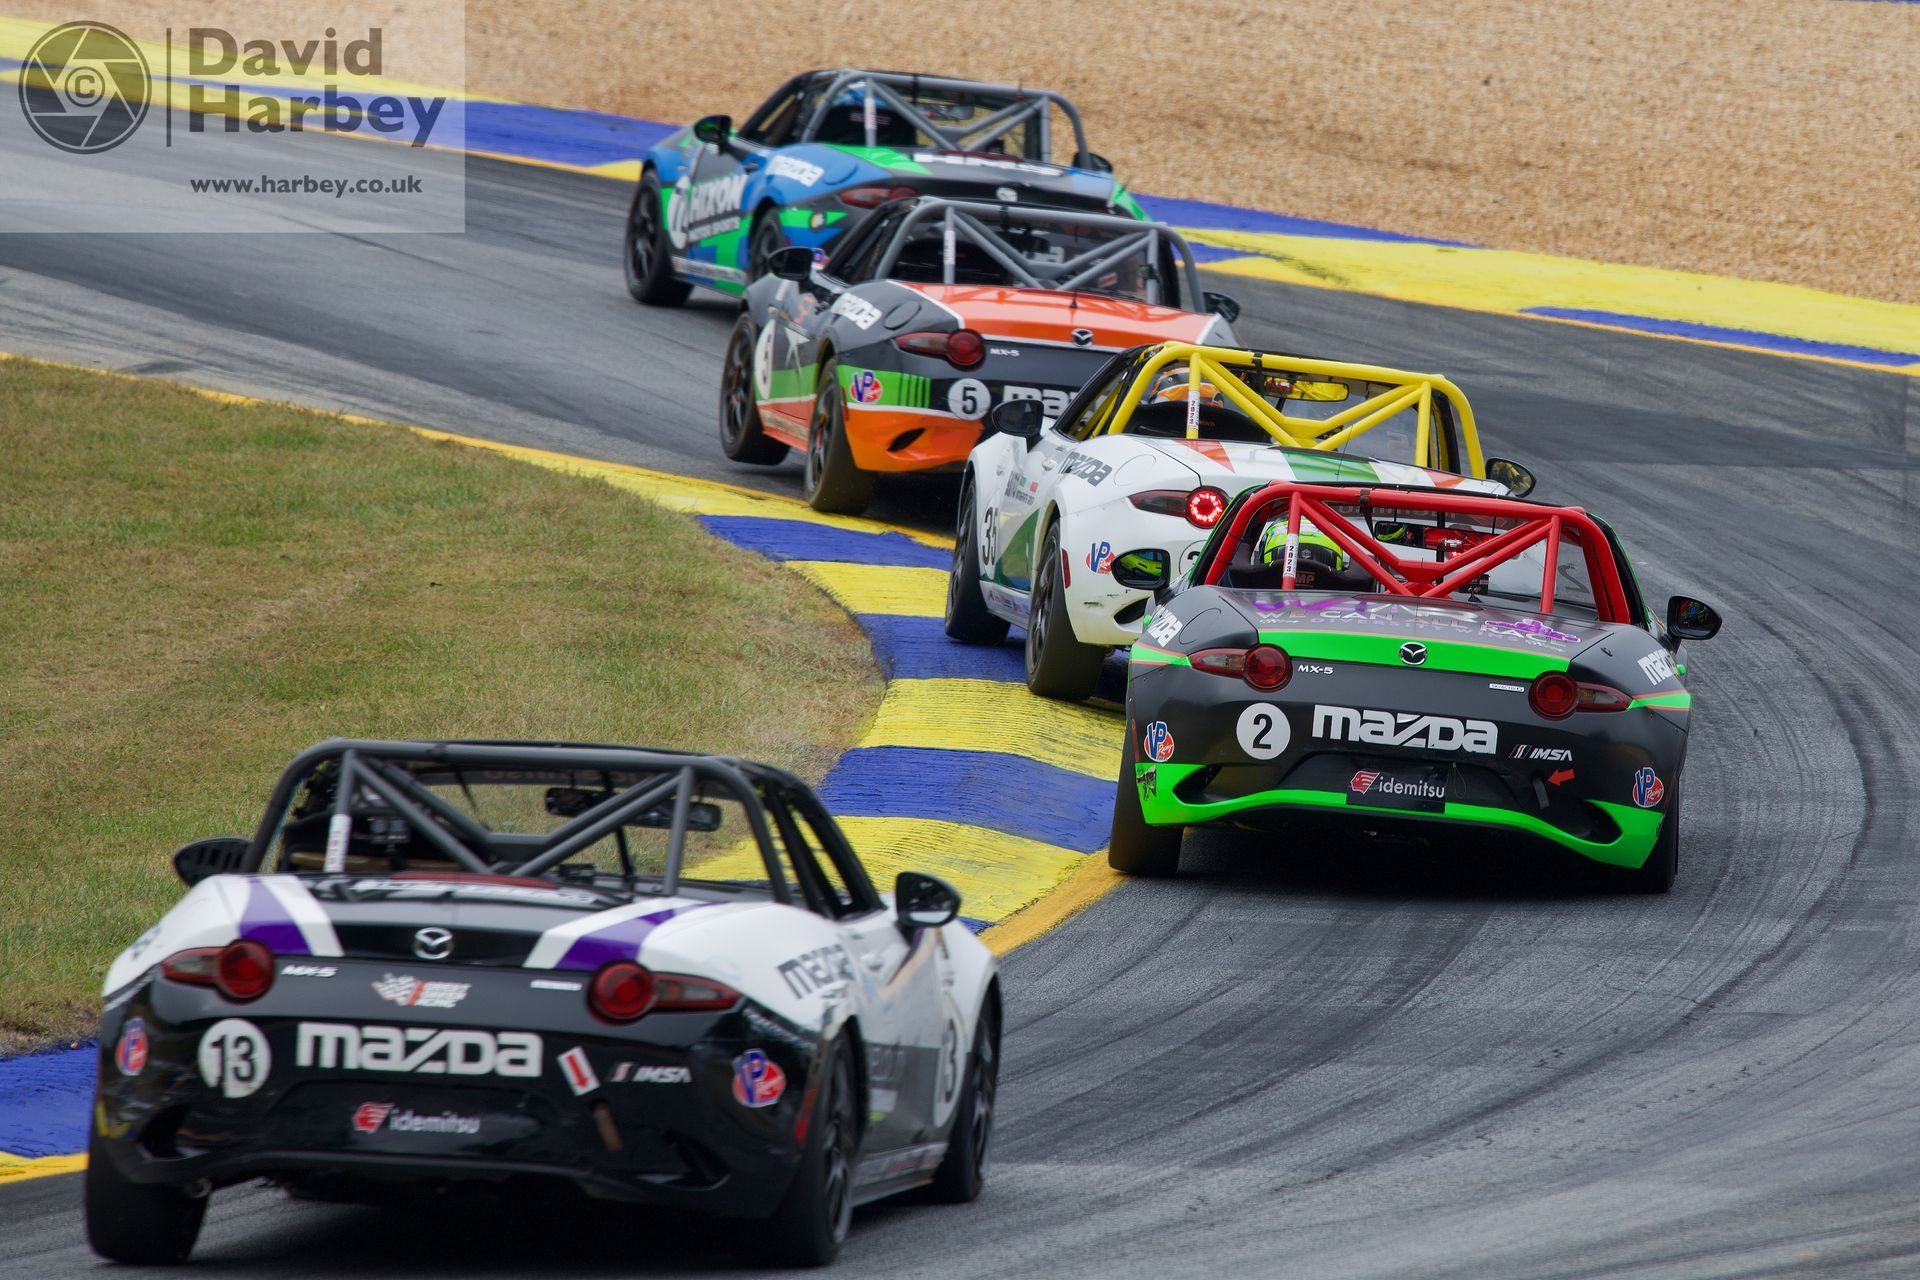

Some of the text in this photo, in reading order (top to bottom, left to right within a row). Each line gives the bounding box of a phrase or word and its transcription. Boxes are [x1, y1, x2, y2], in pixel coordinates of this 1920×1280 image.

[962, 386, 976, 414] 5
[1091, 541, 1111, 573] VP
[1286, 545, 1295, 572] 2023
[1319, 610, 1393, 622] CAN
[1298, 664, 1334, 675] MX-5
[1147, 721, 1168, 760] VP
[1252, 713, 1273, 750] 2
[1311, 704, 1499, 755] mazda
[1529, 748, 1573, 762] IMSA
[1378, 776, 1446, 799] idemitsu
[1635, 767, 1655, 807] VP
[210, 1034, 257, 1084] 13
[296, 1022, 543, 1078] mazda
[631, 1066, 692, 1083] IMSA
[389, 1108, 481, 1134] idemitsu
